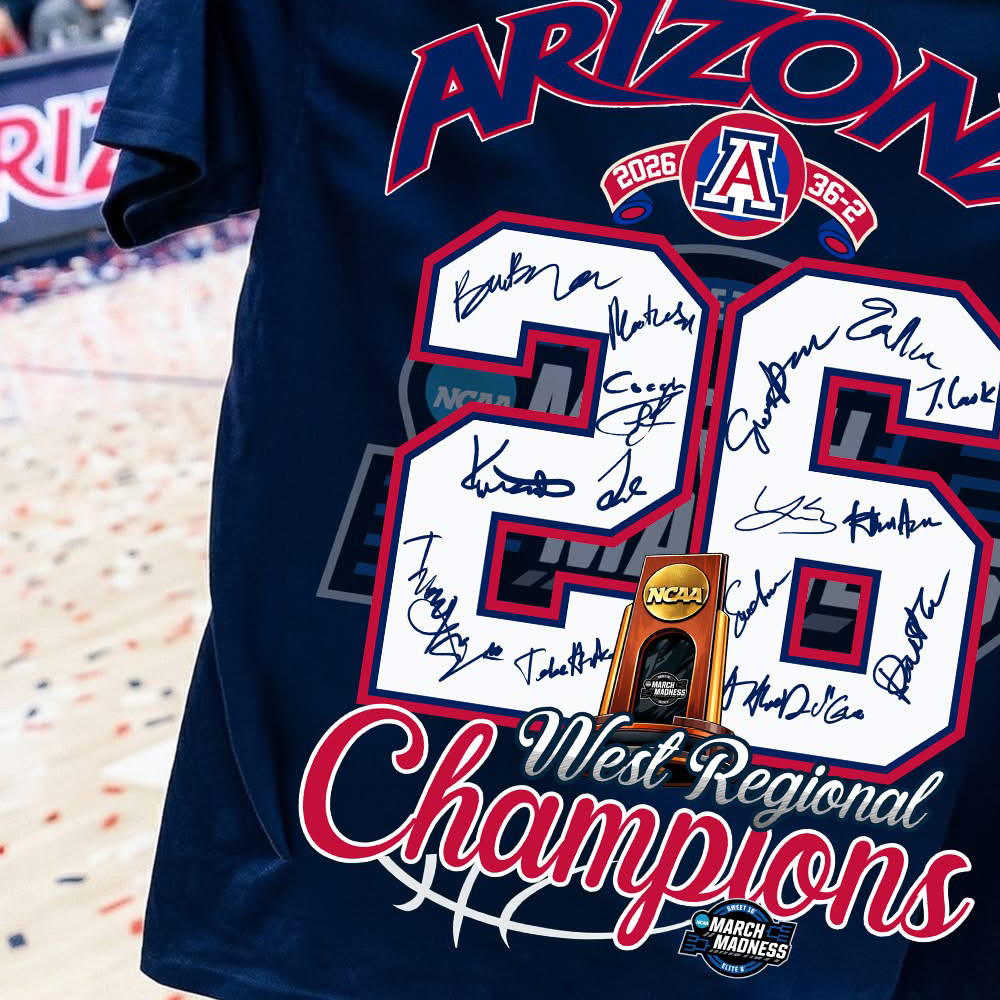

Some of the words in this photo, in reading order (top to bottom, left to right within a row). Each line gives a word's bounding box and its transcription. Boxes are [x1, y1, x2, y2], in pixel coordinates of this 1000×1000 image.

[612, 152, 677, 190] 2026
[807, 172, 867, 225] 36-2
[646, 587, 704, 604] NCAA
[651, 681, 675, 689] MARCH
[653, 688, 686, 696] MADNESS
[519, 710, 686, 789] West
[684, 737, 945, 829] Regional
[298, 703, 976, 951] Champions
[726, 904, 747, 912] SWEET
[747, 905, 756, 914] 16
[708, 916, 766, 939] MARCH
[713, 935, 790, 959] MADNESS
[721, 963, 739, 973] ELITE
